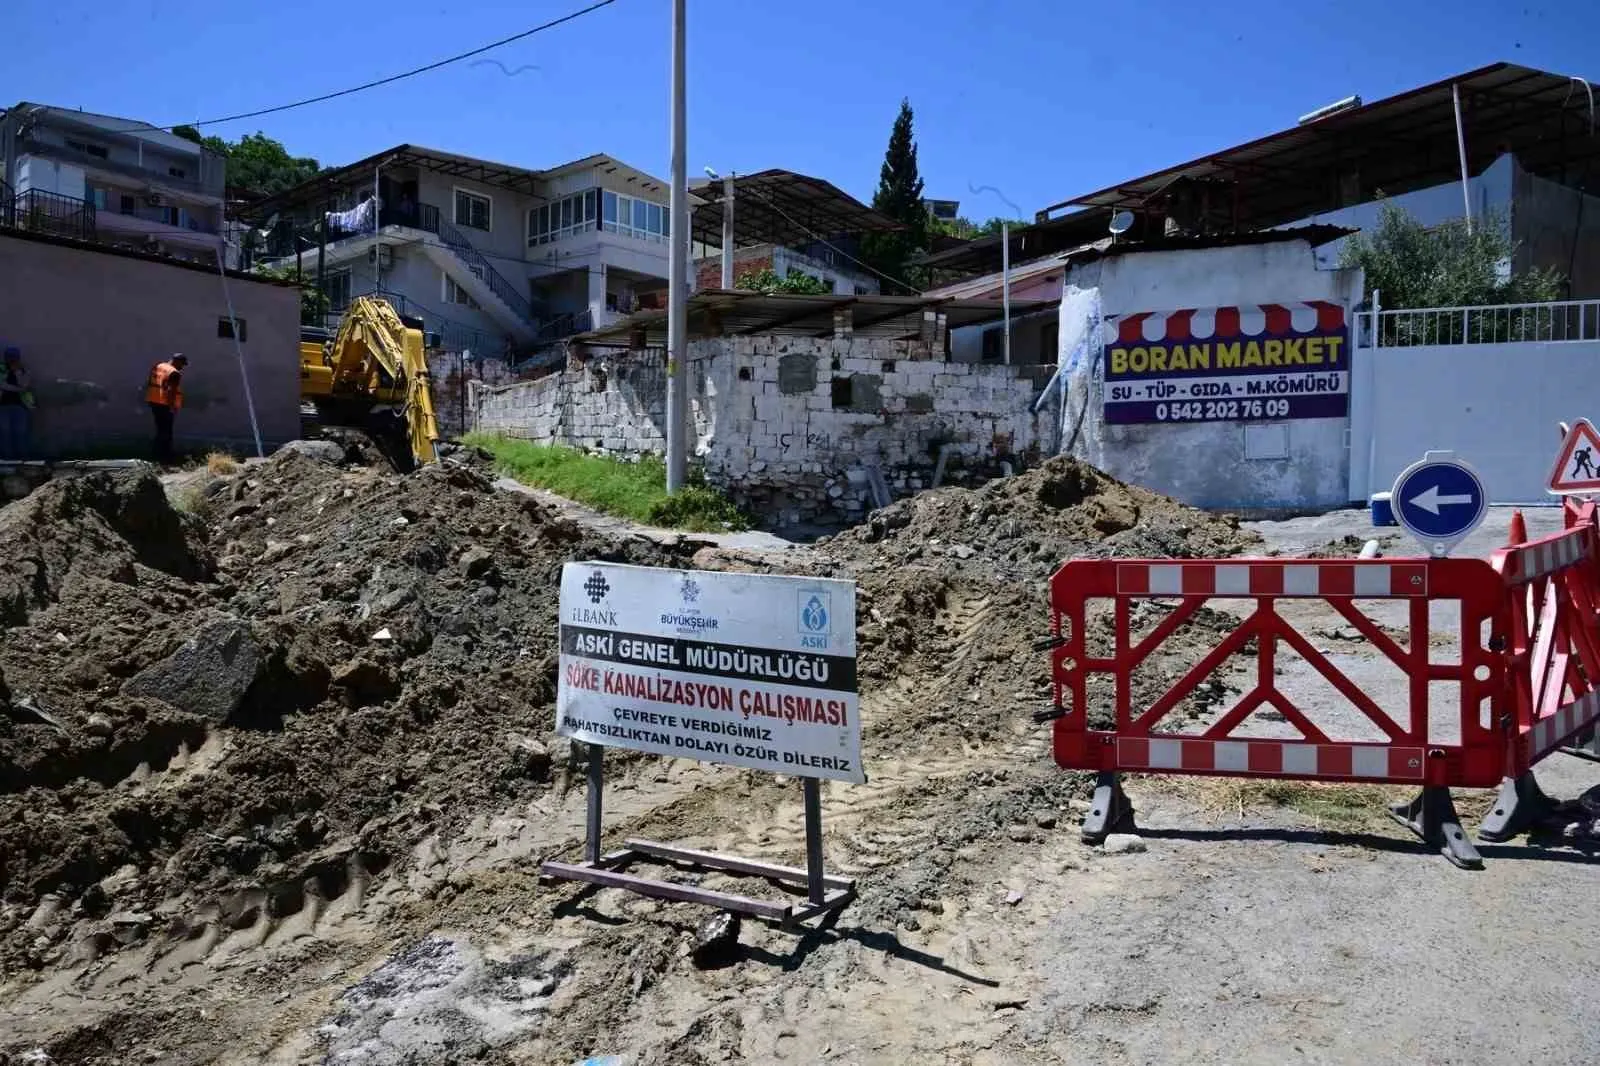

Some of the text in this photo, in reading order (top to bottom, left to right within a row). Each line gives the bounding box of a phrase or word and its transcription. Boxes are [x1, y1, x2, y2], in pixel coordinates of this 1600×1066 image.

[1111, 336, 1344, 374] BORAN MARKET
[1112, 386, 1131, 400] SU
[1145, 381, 1176, 397] TÜP
[1190, 382, 1232, 397] GIDA
[1247, 373, 1340, 395] M.KÖMÜRÜ
[1156, 399, 1289, 420] 0 542 202 76 09
[575, 633, 829, 682] ASKİ GENEL MÜDÜRLÜĞÜ
[566, 661, 848, 727] SÖKE KANALİZASYON ÇALIŞMASI
[614, 707, 773, 742] ÇEVREYE VERDİĞİMİZ
[563, 716, 851, 772] RAHATSIZLIKTAN DOLAYI ÖZÜR DİLERİZ
